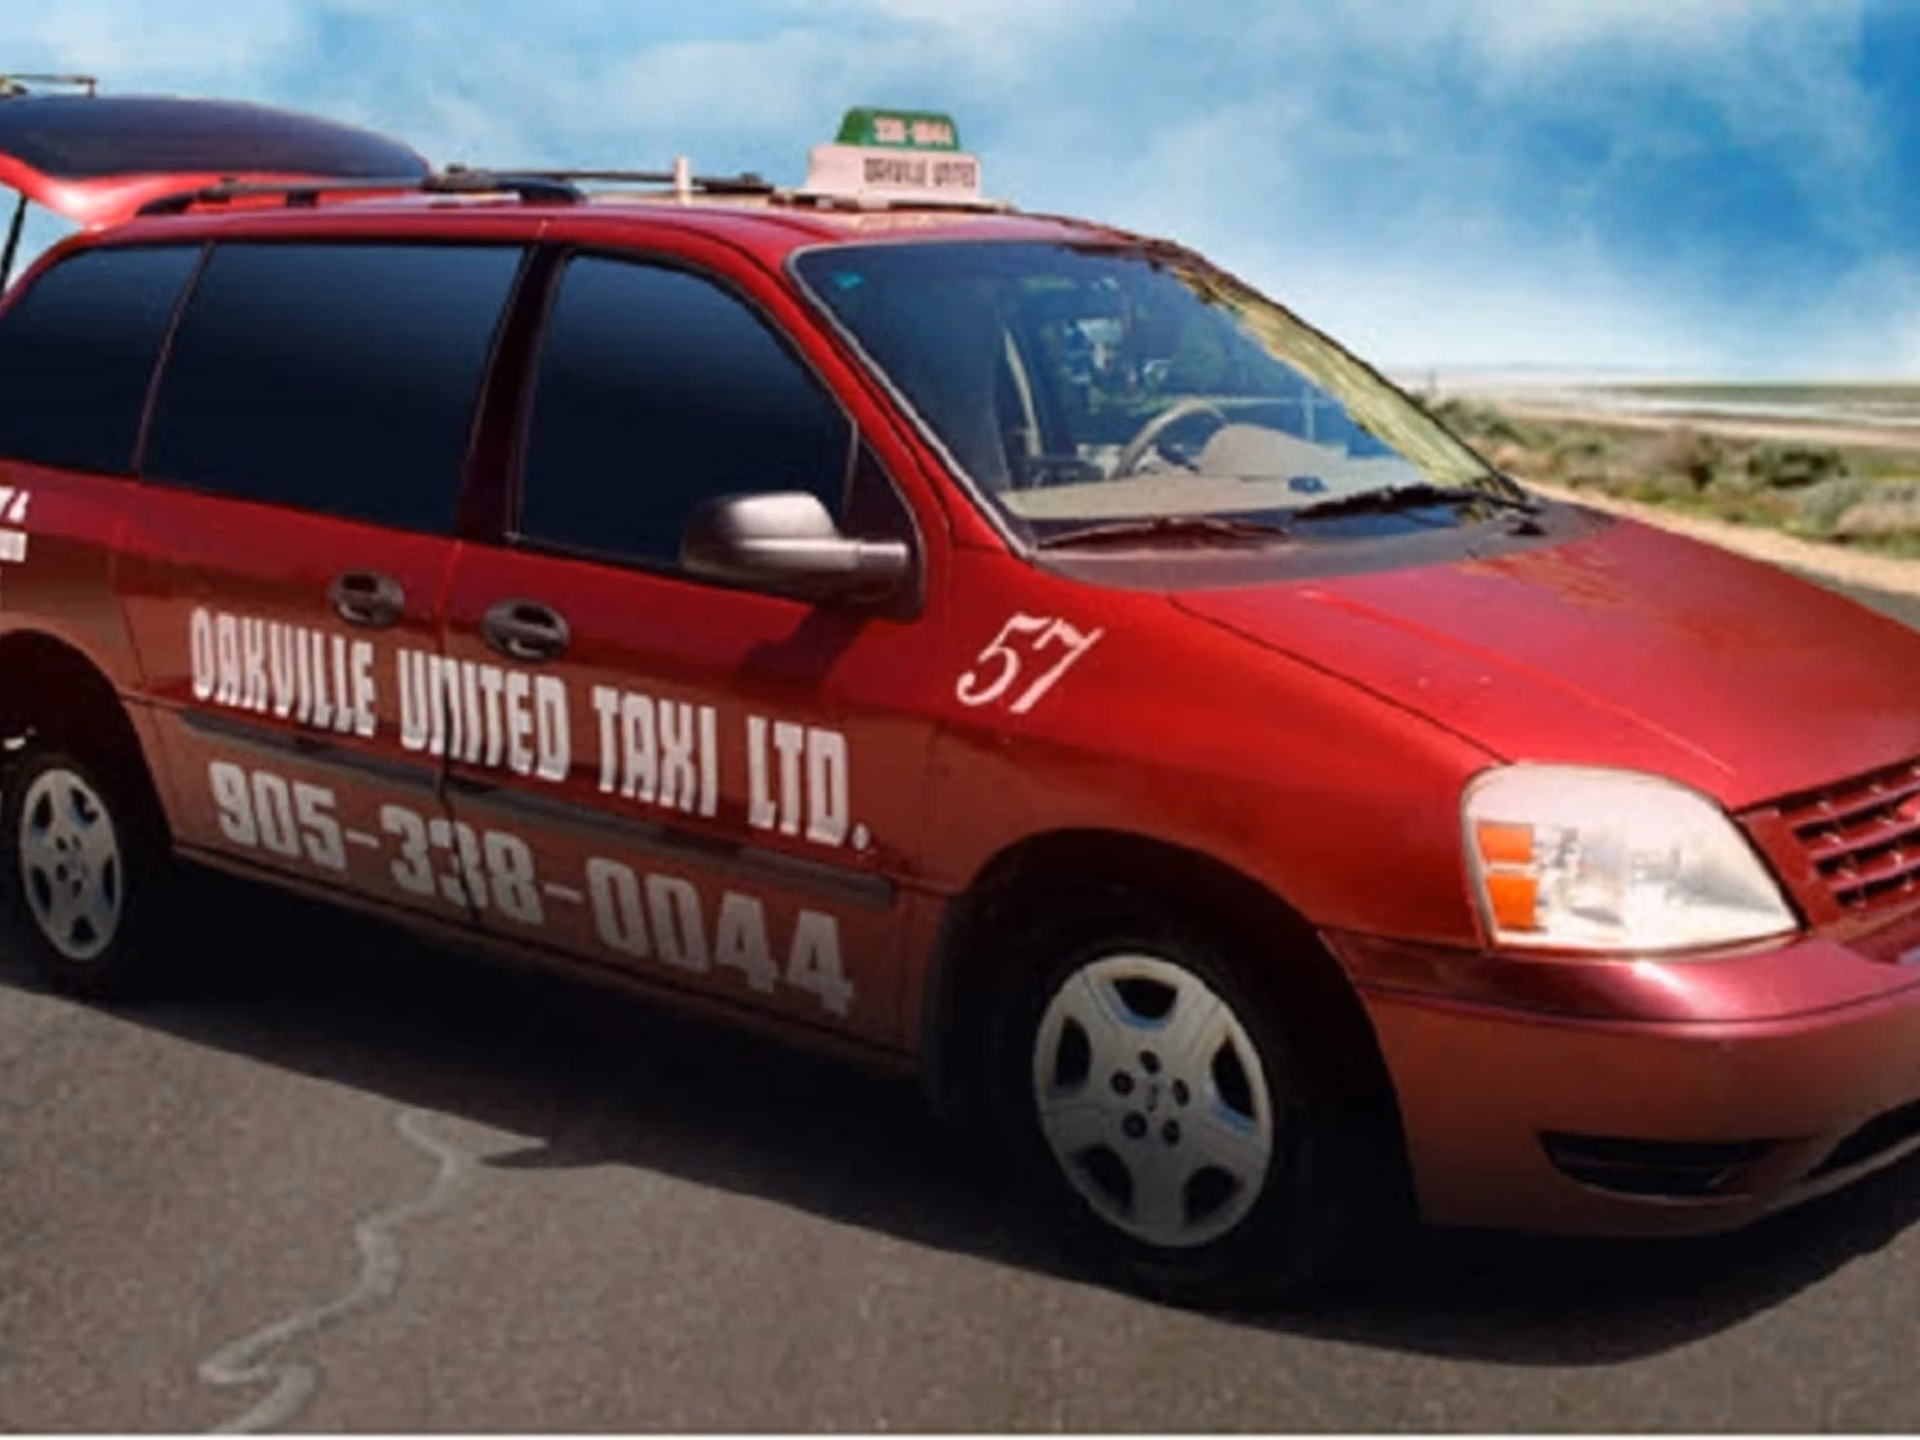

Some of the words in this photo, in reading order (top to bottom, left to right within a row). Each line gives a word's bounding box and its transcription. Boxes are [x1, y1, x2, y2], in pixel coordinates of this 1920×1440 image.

[190, 607, 376, 737] OAKVILLE
[397, 647, 571, 782] UNITED
[593, 684, 717, 818] TAXI
[746, 714, 870, 848] LTD.
[956, 611, 1104, 714] 57
[208, 760, 855, 1017] 905-338-0044
